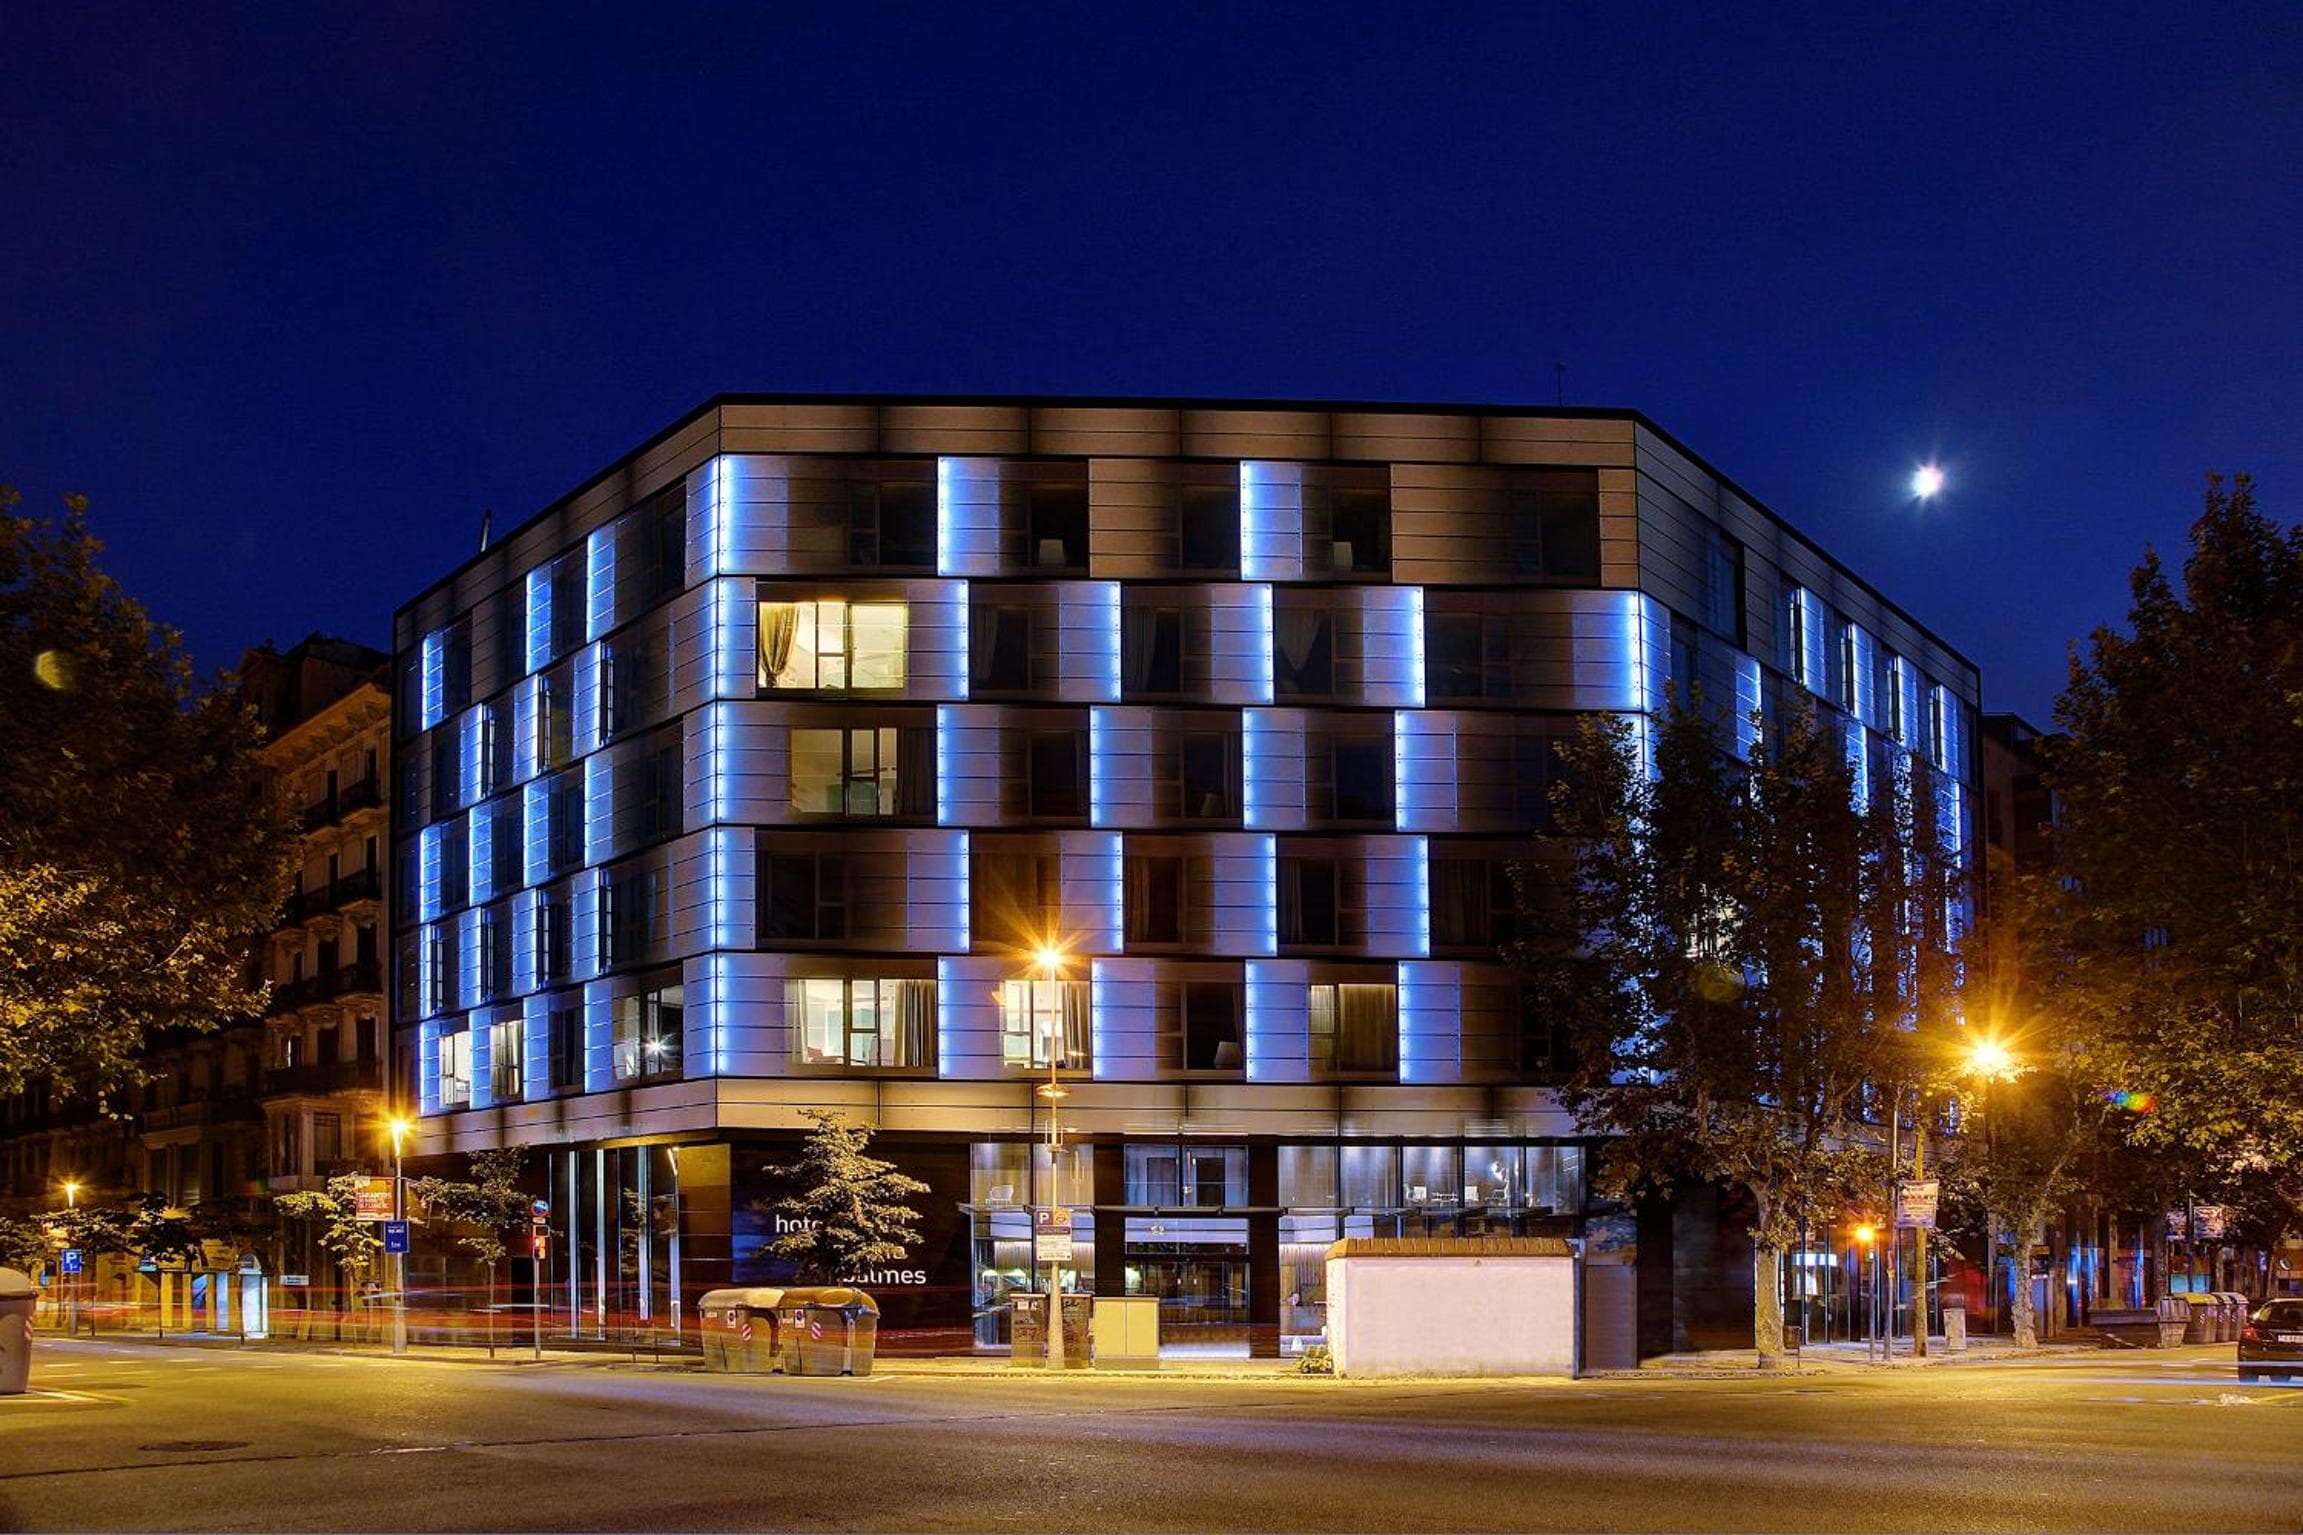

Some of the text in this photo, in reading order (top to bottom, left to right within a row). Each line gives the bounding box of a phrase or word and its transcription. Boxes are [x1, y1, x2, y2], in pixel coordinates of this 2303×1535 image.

[776, 1214, 824, 1233] hot
[1039, 1212, 1050, 1225] P
[66, 1252, 77, 1264] P
[842, 1265, 927, 1285] almes
